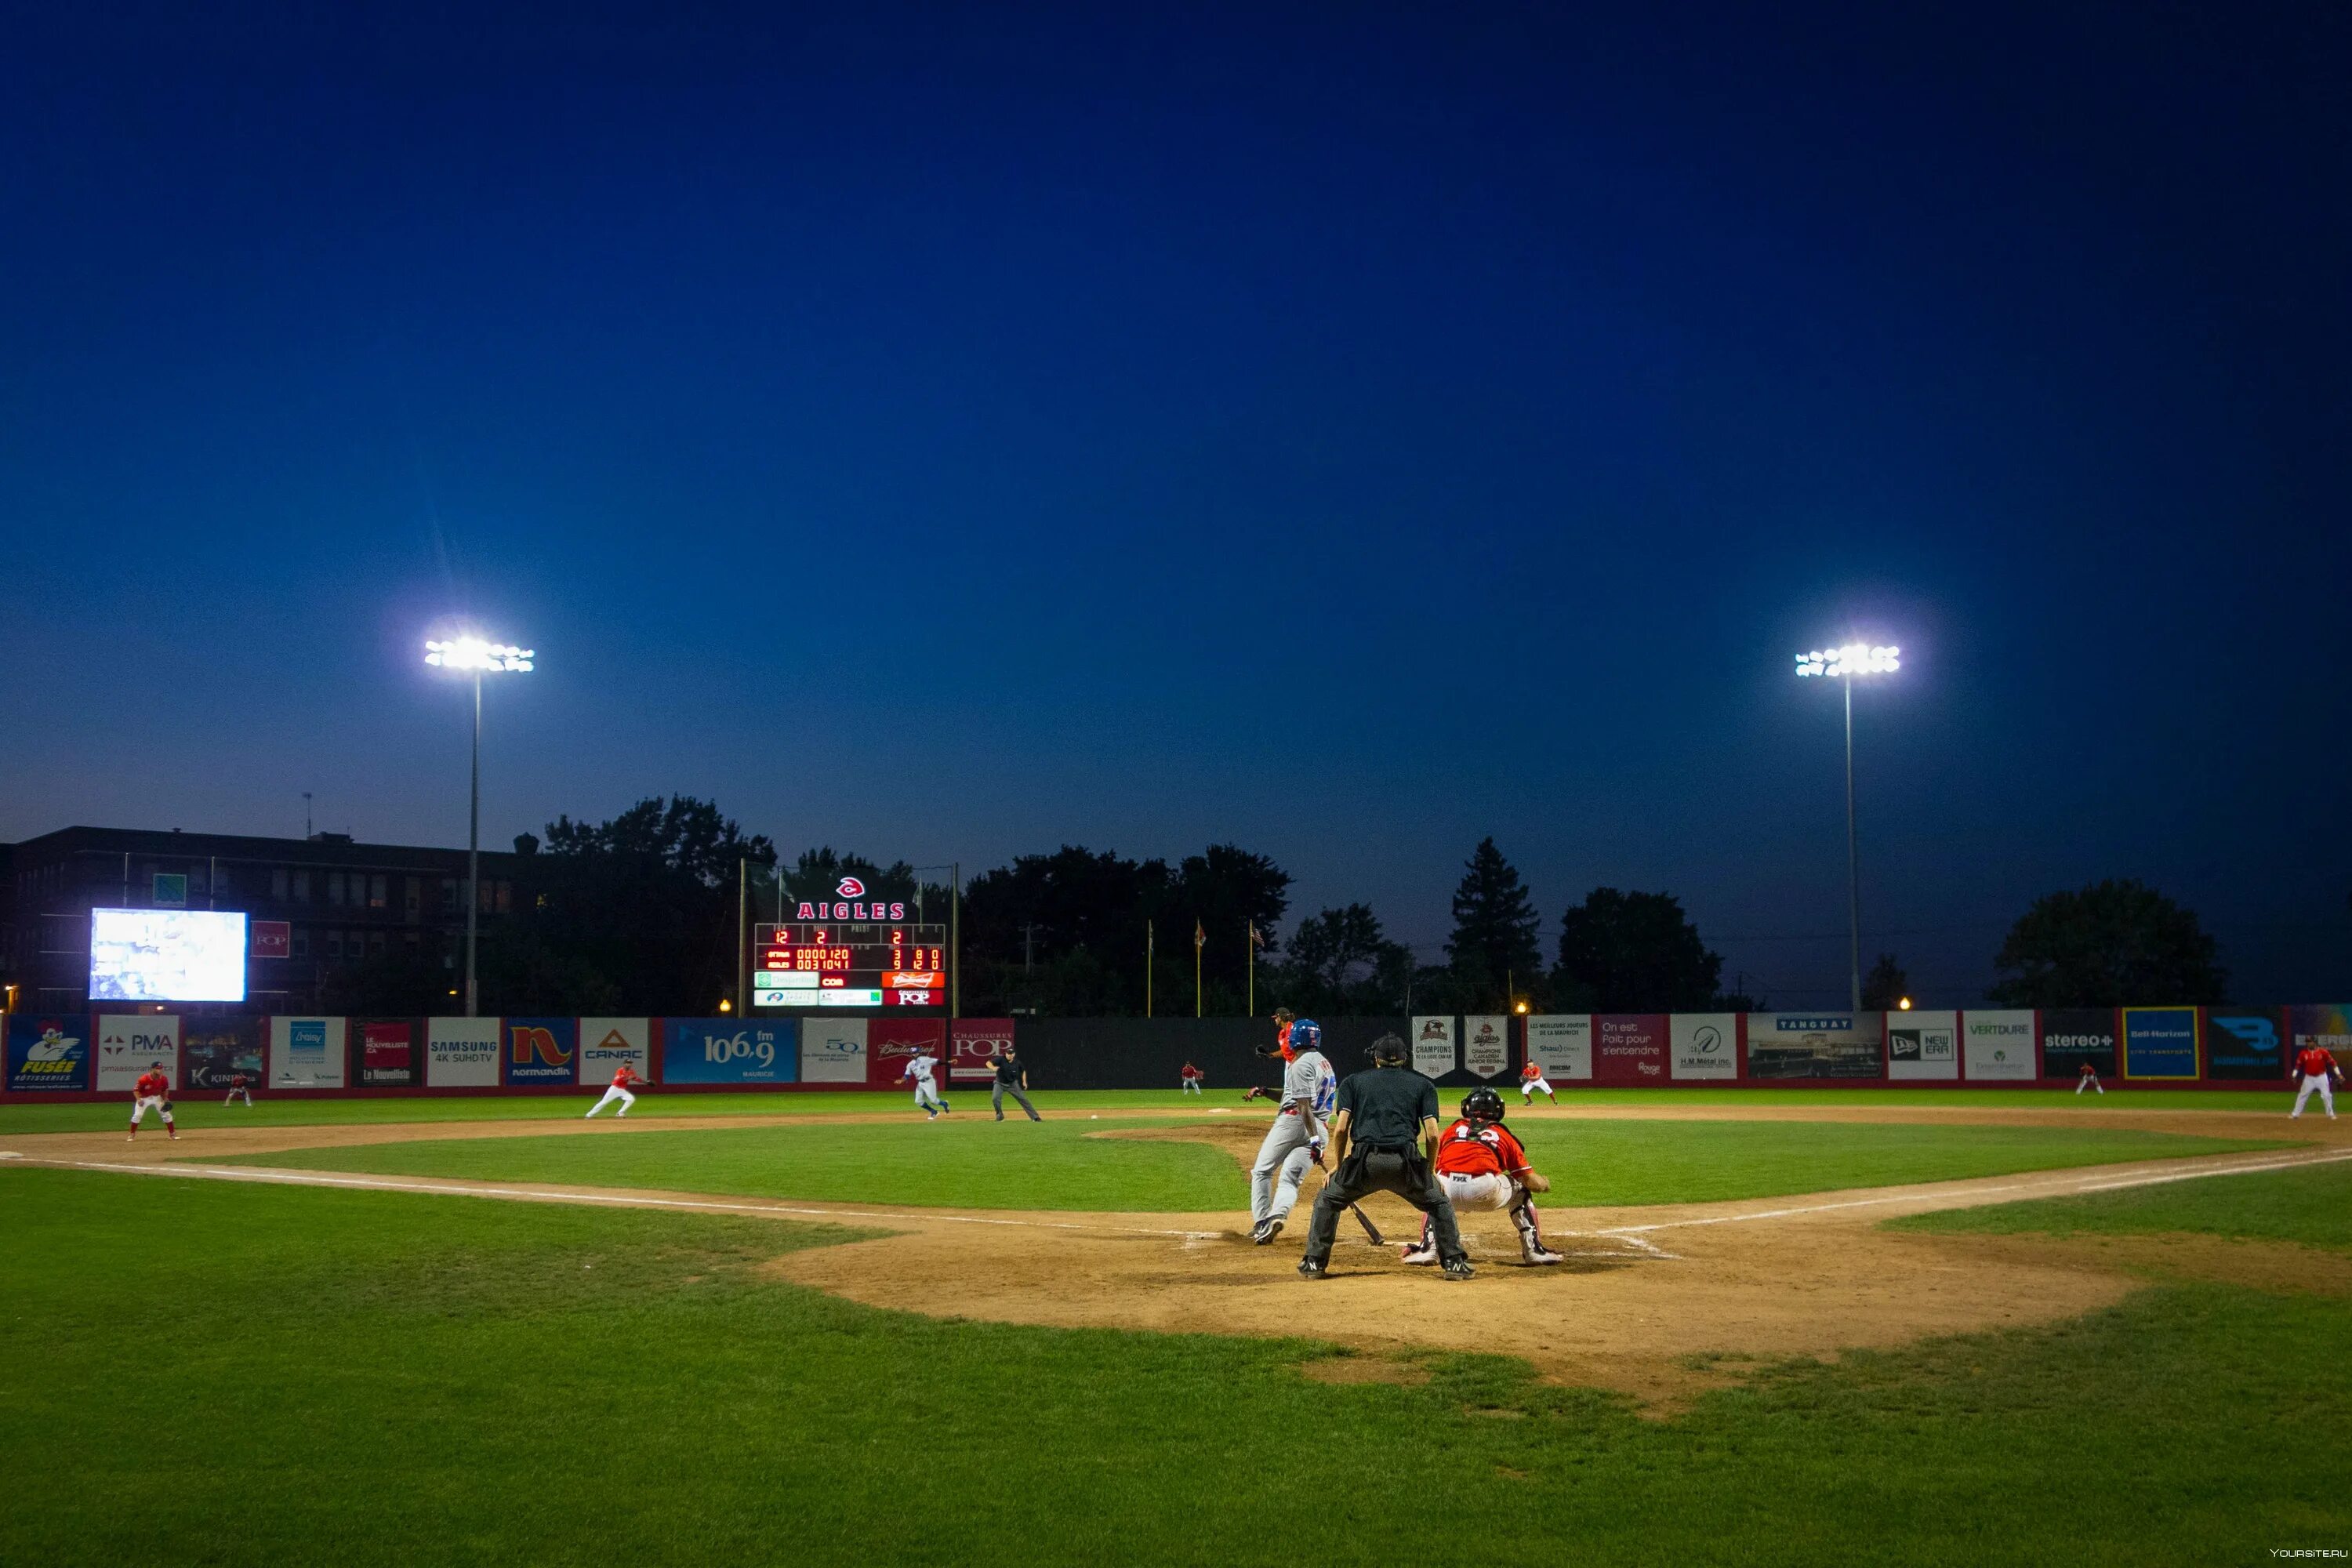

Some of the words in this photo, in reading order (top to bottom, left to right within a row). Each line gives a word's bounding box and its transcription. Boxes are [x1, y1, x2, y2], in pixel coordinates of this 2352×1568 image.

[797, 902, 904, 919] AIGLES
[775, 931, 788, 944] 12
[816, 931, 826, 944] 2
[892, 931, 901, 944] 2
[895, 949, 901, 959] 3
[916, 949, 923, 959] 8
[931, 949, 938, 959] 0
[894, 960, 901, 970] 9
[913, 960, 923, 970] 12
[931, 960, 938, 970] 0
[1602, 1022, 1617, 1032] On
[1620, 1023, 1637, 1032] est
[131, 1034, 173, 1051] PMA
[1626, 1036, 1652, 1046] pour
[1926, 1035, 1948, 1045] NEW
[431, 1042, 497, 1052] SAMSUNG
[953, 1040, 1012, 1057] POP
[1602, 1046, 1660, 1056] s'entendre
[1926, 1045, 1949, 1054] ERA
[435, 1054, 448, 1062] 4K
[585, 1050, 643, 1059] CANAC
[20, 1059, 77, 1073] FUSÉE
[1638, 1062, 1661, 1075] Rouge
[363, 1069, 372, 1080] Le
[373, 1069, 411, 1080] Nouvelliste
[512, 1067, 571, 1076] normandin
[1308, 1261, 1318, 1271] N
[1453, 1263, 1462, 1272] N
